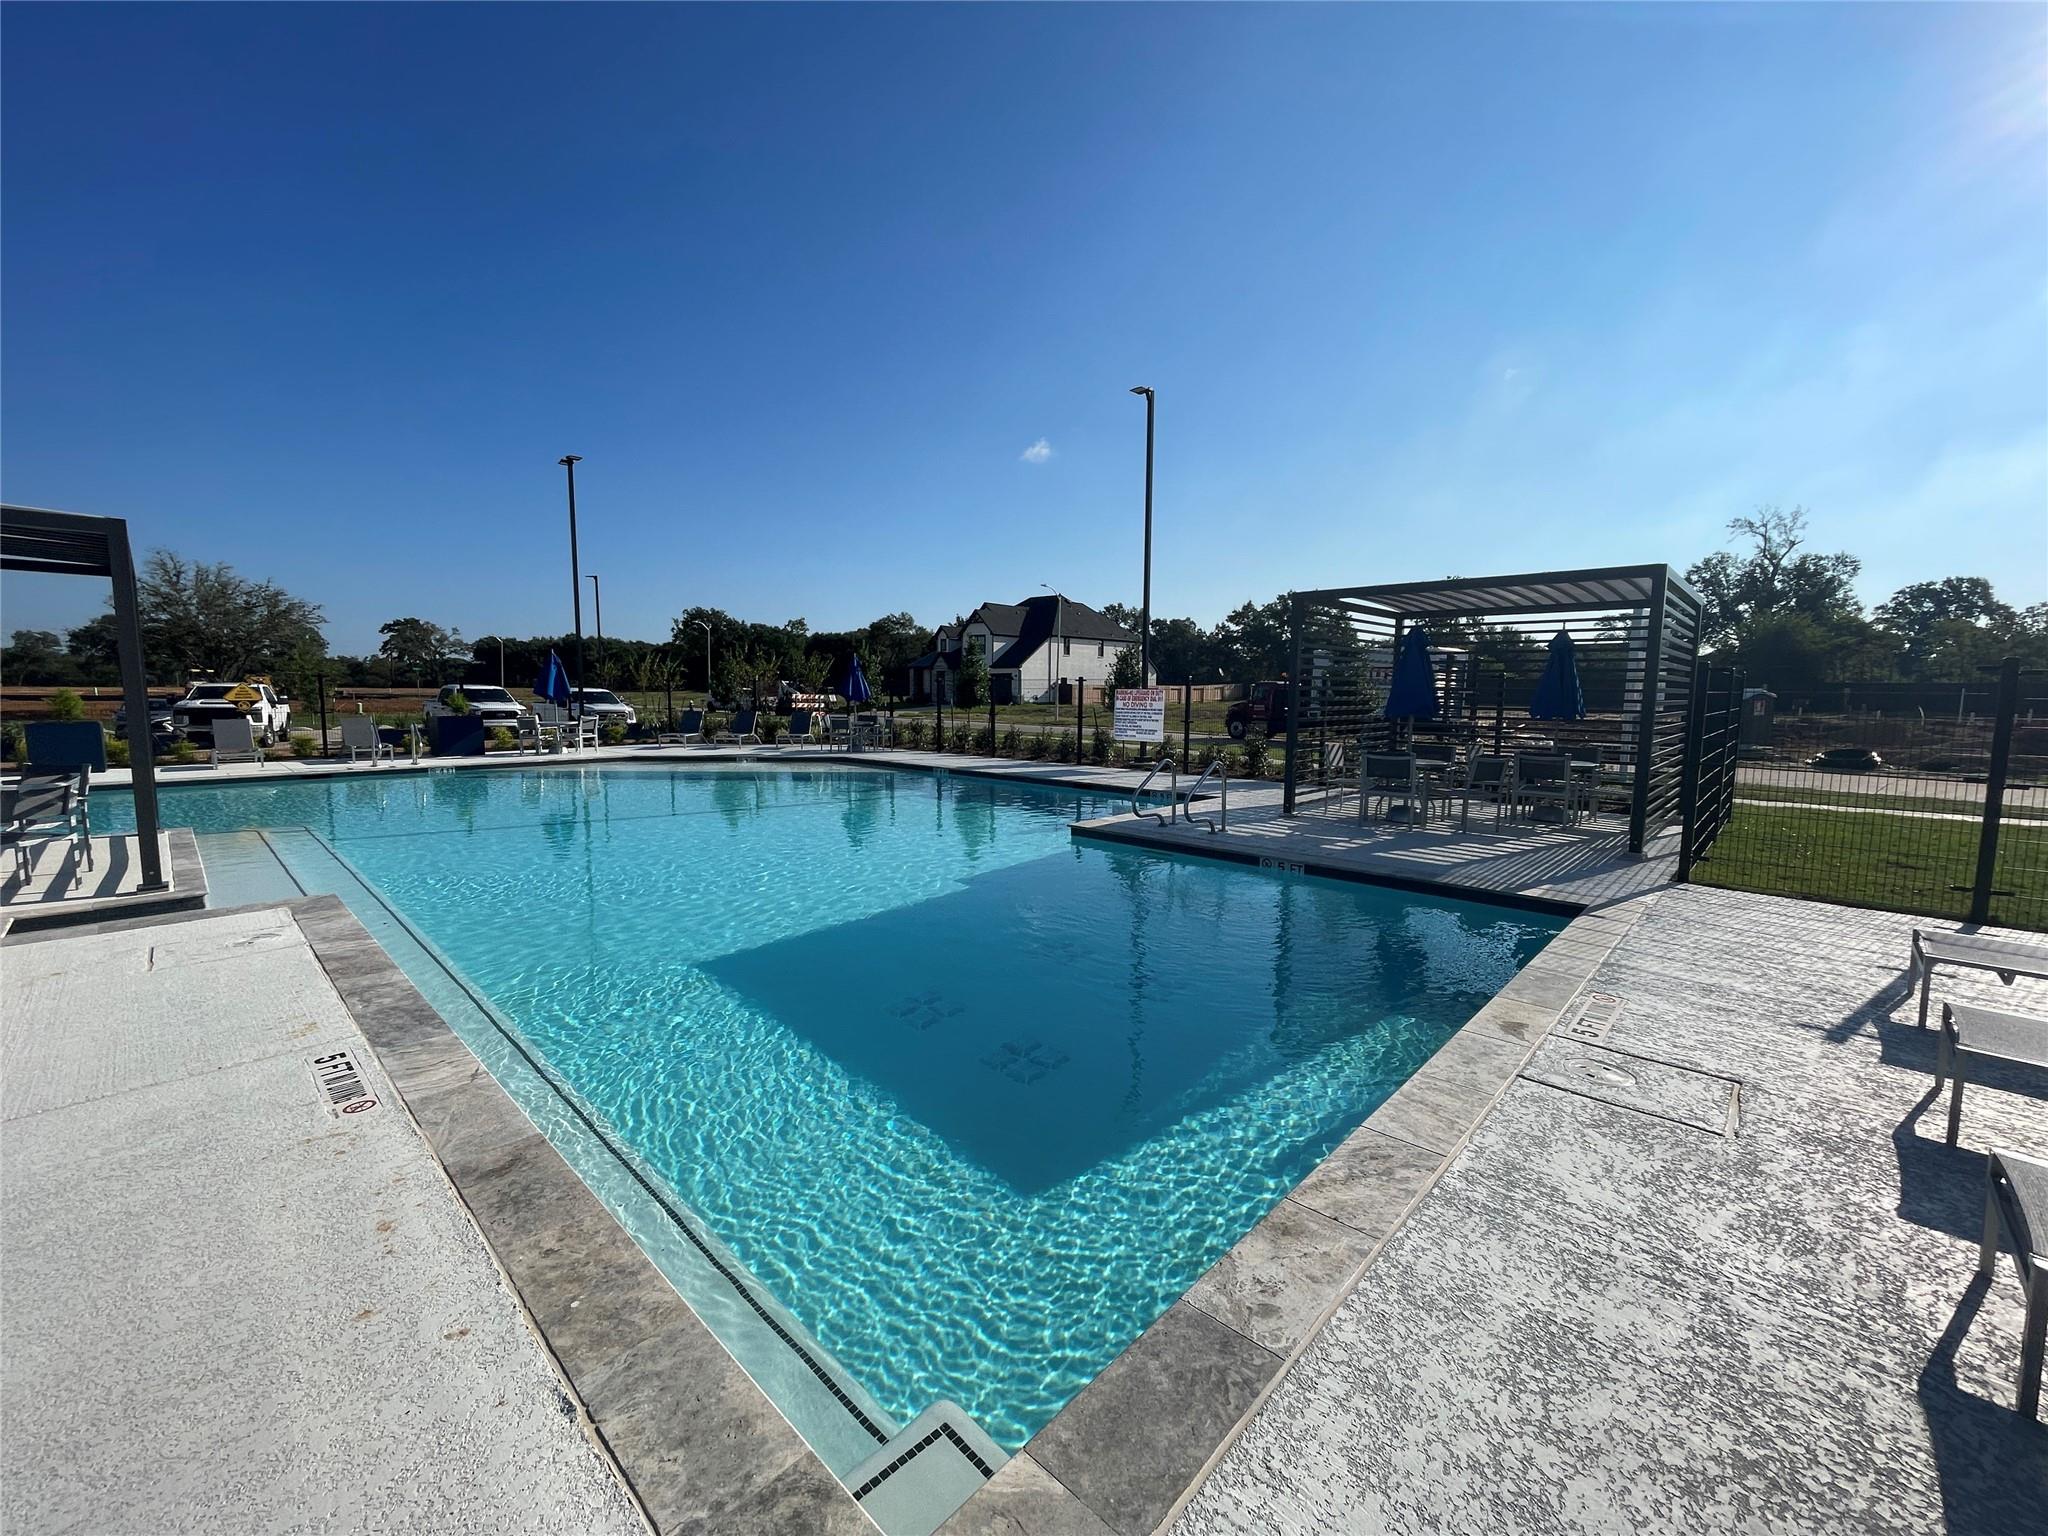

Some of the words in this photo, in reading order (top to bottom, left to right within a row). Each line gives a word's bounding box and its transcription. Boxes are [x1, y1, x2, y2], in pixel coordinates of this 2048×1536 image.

[1278, 862, 1285, 871] 5
[1290, 863, 1303, 874] FT
[1577, 1017, 1606, 1031] FT
[1571, 1028, 1600, 1037] 5
[314, 1052, 347, 1064] 5
[317, 1061, 354, 1077] FT
